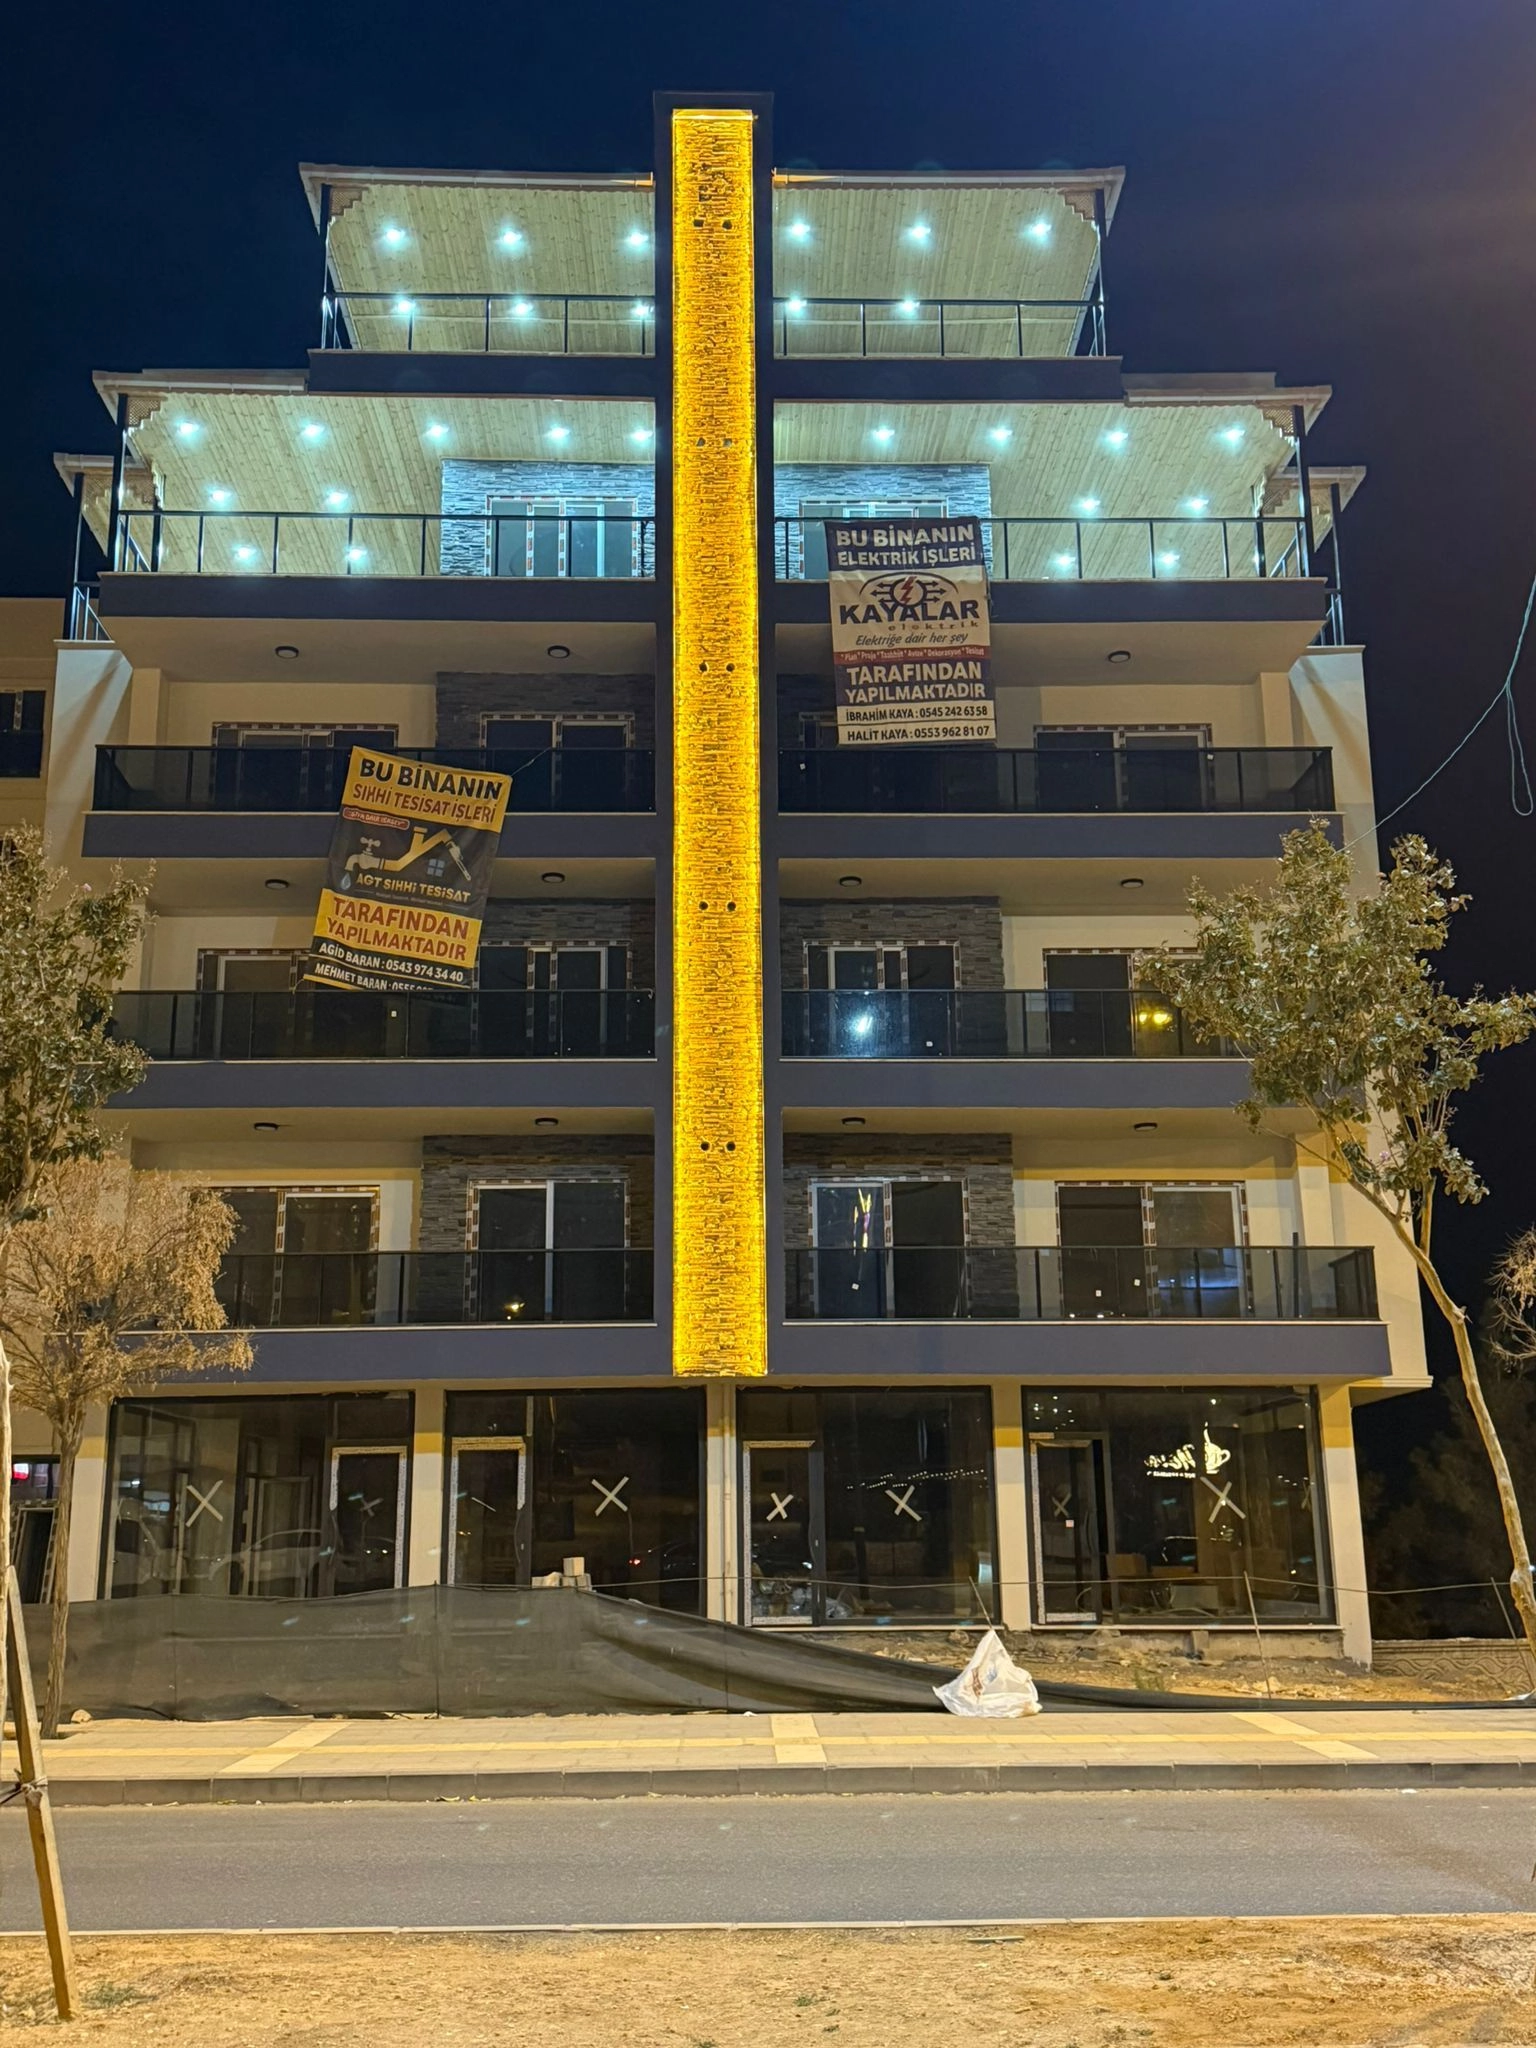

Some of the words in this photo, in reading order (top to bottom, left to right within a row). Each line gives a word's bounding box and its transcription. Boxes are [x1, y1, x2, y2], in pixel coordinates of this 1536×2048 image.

[836, 529, 867, 547] BU
[873, 524, 975, 547] BİNANIN
[837, 547, 919, 566] ELEKTRİK
[922, 542, 976, 567] İŞLERİ
[839, 599, 980, 625] KAYALAR
[888, 621, 979, 631] elektrik
[855, 633, 902, 647] Elektriğe
[904, 632, 925, 644] dair
[928, 632, 947, 644] her
[950, 632, 969, 645] şey
[846, 661, 982, 686] TARAFINDAN
[845, 682, 986, 704] YAPILMAKTADIR
[846, 707, 888, 722] İBRAHİM
[889, 708, 914, 719] KAYA
[919, 707, 943, 718] 0545
[945, 706, 962, 717] 242
[847, 728, 879, 741] HALİT
[881, 729, 909, 740] KAYA
[914, 727, 940, 738] 0553
[942, 727, 961, 737] 962
[963, 726, 974, 737] 81
[976, 725, 990, 736] 07
[359, 758, 394, 782] BU
[397, 764, 503, 800] BİNANIN
[353, 783, 393, 805] SIHHİ
[394, 793, 450, 816] TESİSAT
[451, 799, 498, 823] İŞLERİ
[356, 873, 383, 888] AGT
[333, 897, 469, 940] TARAFINDAN
[327, 917, 468, 961] YAPILMAKTADIR
[318, 942, 345, 958] AGİD
[345, 952, 381, 969] BARAN
[385, 960, 411, 974] 0543
[414, 964, 433, 977] 974
[434, 968, 448, 979] 34
[449, 971, 464, 982] 40
[315, 963, 356, 982] MEHMET
[357, 975, 388, 990] BARAN
